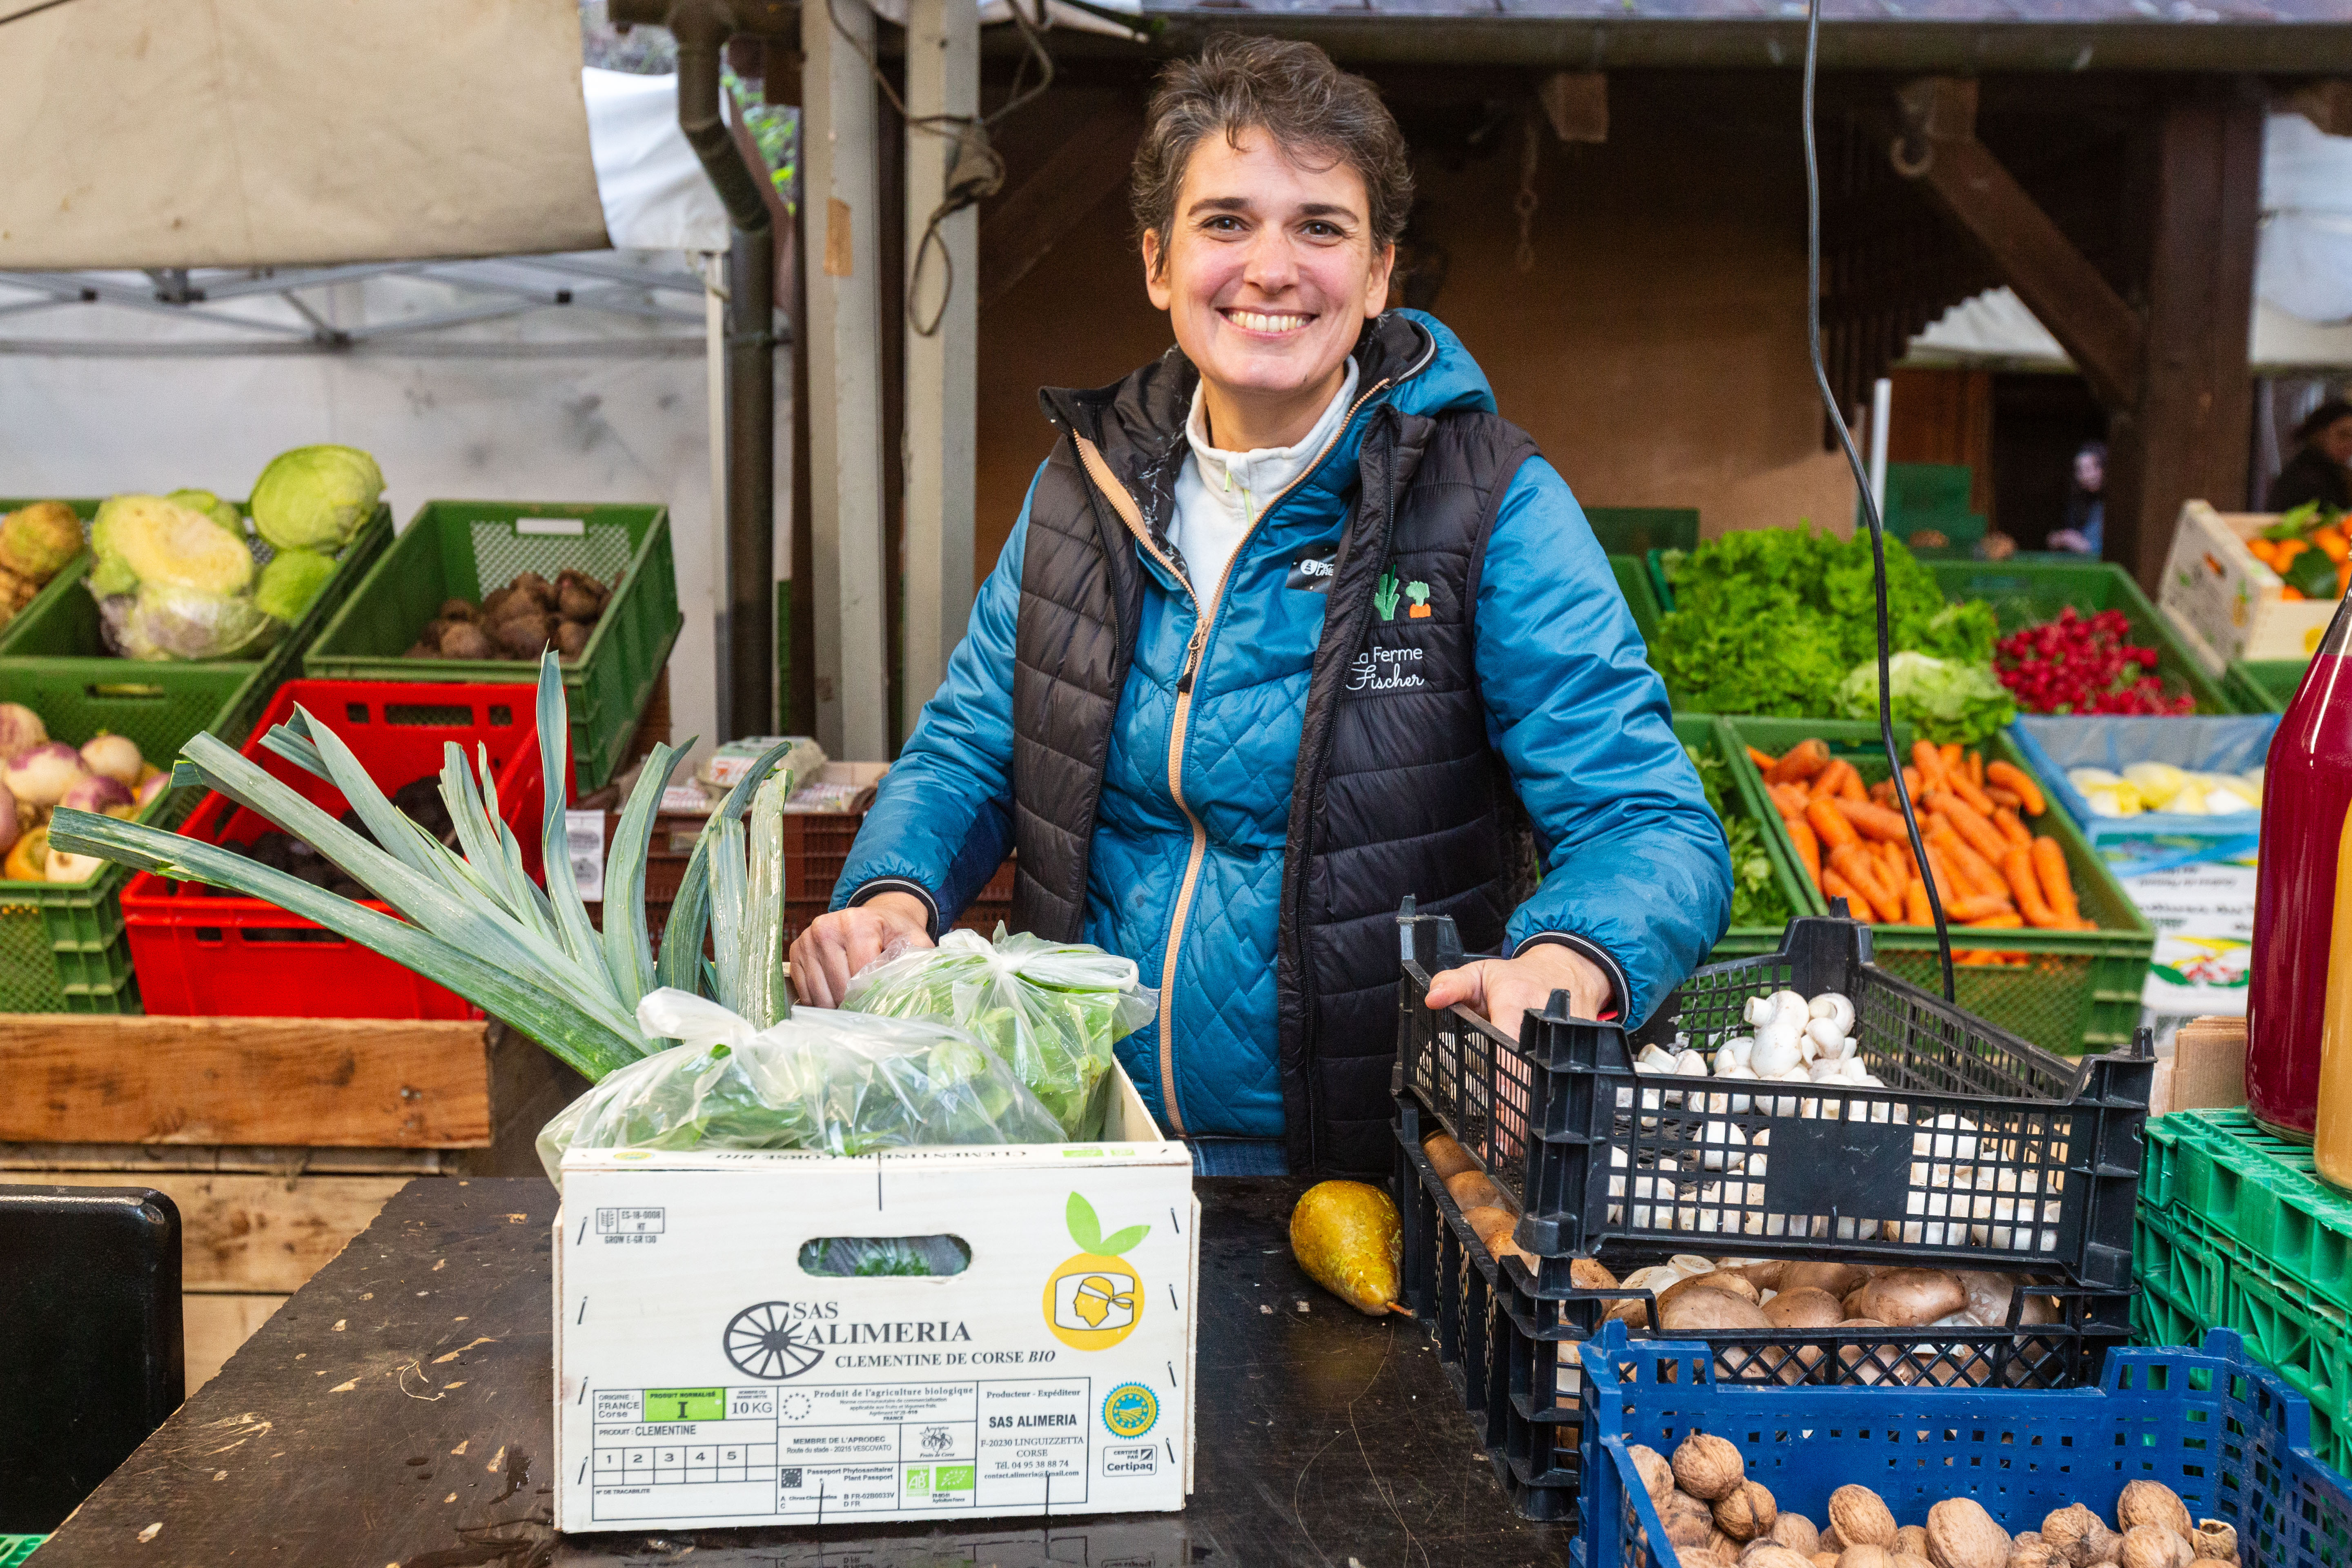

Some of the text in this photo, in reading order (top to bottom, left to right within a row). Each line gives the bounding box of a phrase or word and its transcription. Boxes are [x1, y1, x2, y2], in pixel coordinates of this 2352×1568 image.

[1374, 646, 1423, 663] Ferme
[1346, 664, 1425, 690] Fischer
[793, 1301, 838, 1320] SAS
[803, 1321, 973, 1346] ALIMERIA
[835, 1350, 1055, 1368] CLEMENTINE DE CORSE BIO
[814, 1390, 849, 1398] Produit
[925, 1387, 973, 1396] biologique
[1038, 1389, 1081, 1398] Expéditeur
[599, 1402, 639, 1410] FRANCE
[677, 1401, 688, 1419] I
[732, 1402, 772, 1414] 10 KG
[989, 1414, 1077, 1428] SAS ALIMERIA
[635, 1425, 696, 1436] CLEMENTINE
[980, 1437, 1084, 1448] F-20230 LINGUIZZETTA
[606, 1455, 612, 1464] 1
[633, 1454, 643, 1463] 2
[664, 1453, 674, 1462] 3
[695, 1452, 706, 1461] 4
[727, 1451, 737, 1460] 5
[995, 1461, 1009, 1470] Tél.
[1107, 1462, 1153, 1472] Certipaq
[908, 1475, 926, 1489] AB
